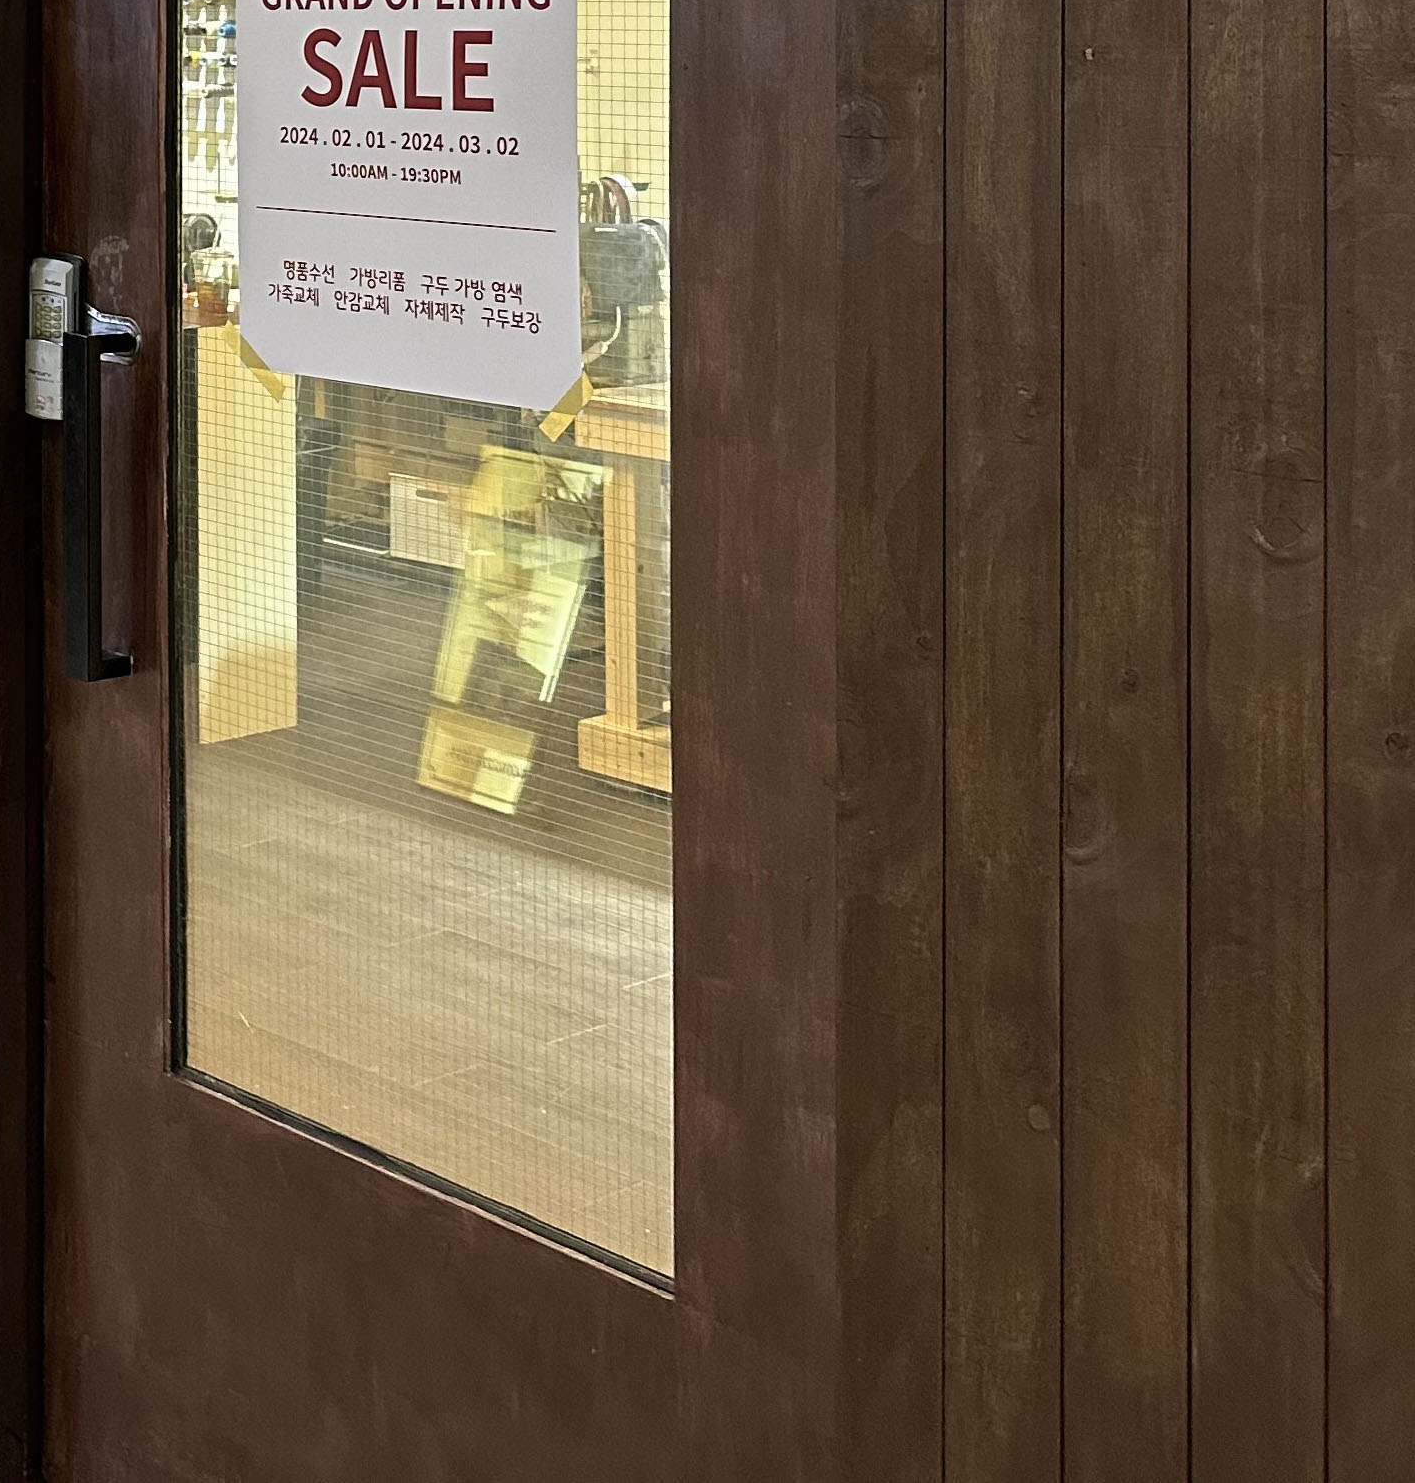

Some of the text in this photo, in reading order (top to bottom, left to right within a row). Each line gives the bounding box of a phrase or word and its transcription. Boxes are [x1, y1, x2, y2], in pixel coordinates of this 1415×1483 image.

[300, 28, 495, 113] SALE
[330, 162, 389, 181] 10:00AM
[400, 167, 462, 185] 19:30PM
[283, 260, 523, 306] 명품수선 가방리폼 구두 가방 염색
[268, 283, 543, 335] 가죽교체 안감교체 자체제작 구두보강
